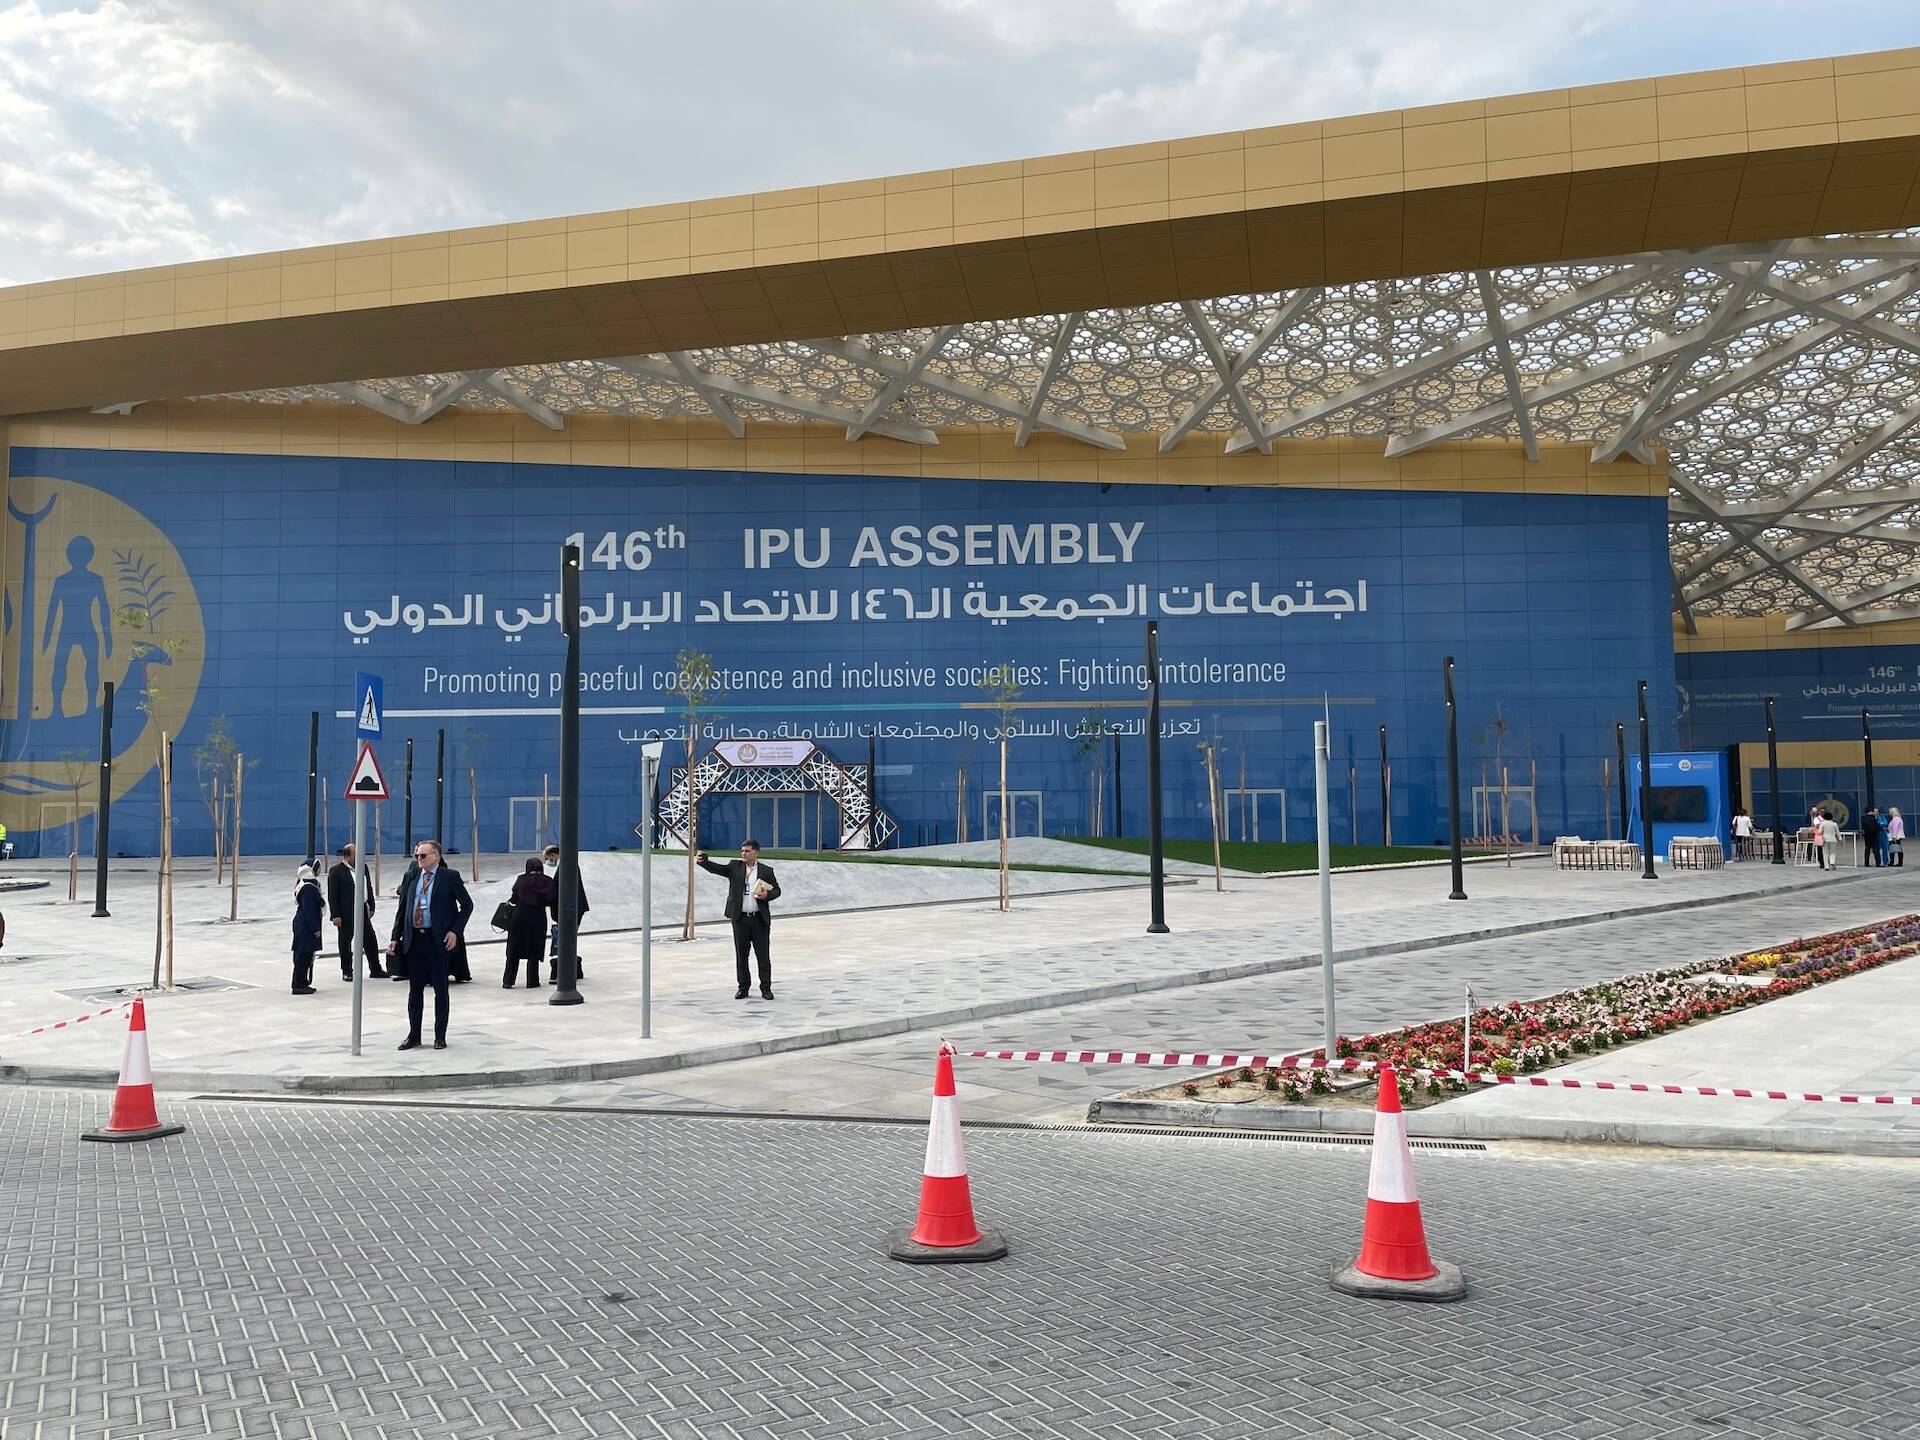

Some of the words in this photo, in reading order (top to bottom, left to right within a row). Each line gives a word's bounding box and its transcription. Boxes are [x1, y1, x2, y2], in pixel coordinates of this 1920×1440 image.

[565, 524, 686, 571] 146th
[744, 527, 831, 569] IPU
[850, 521, 1145, 568] ASSEMBLY
[694, 589, 838, 623] للاتحاد
[963, 581, 1147, 626] الجمعية
[1159, 579, 1367, 620] اجتماعات
[343, 593, 484, 644] الدولي
[423, 665, 540, 698] Promoting
[549, 664, 643, 698] paceful
[652, 663, 783, 690] coexistence
[792, 662, 832, 689] and
[842, 661, 936, 688] inclusive
[945, 659, 1048, 687] societies:
[1059, 658, 1148, 692] Fighting
[1159, 657, 1286, 684] intolerance
[618, 723, 698, 744] التعصب
[858, 720, 978, 741] والمجتمعات
[983, 719, 1060, 744] السلمي
[1159, 718, 1200, 738] تعزي
